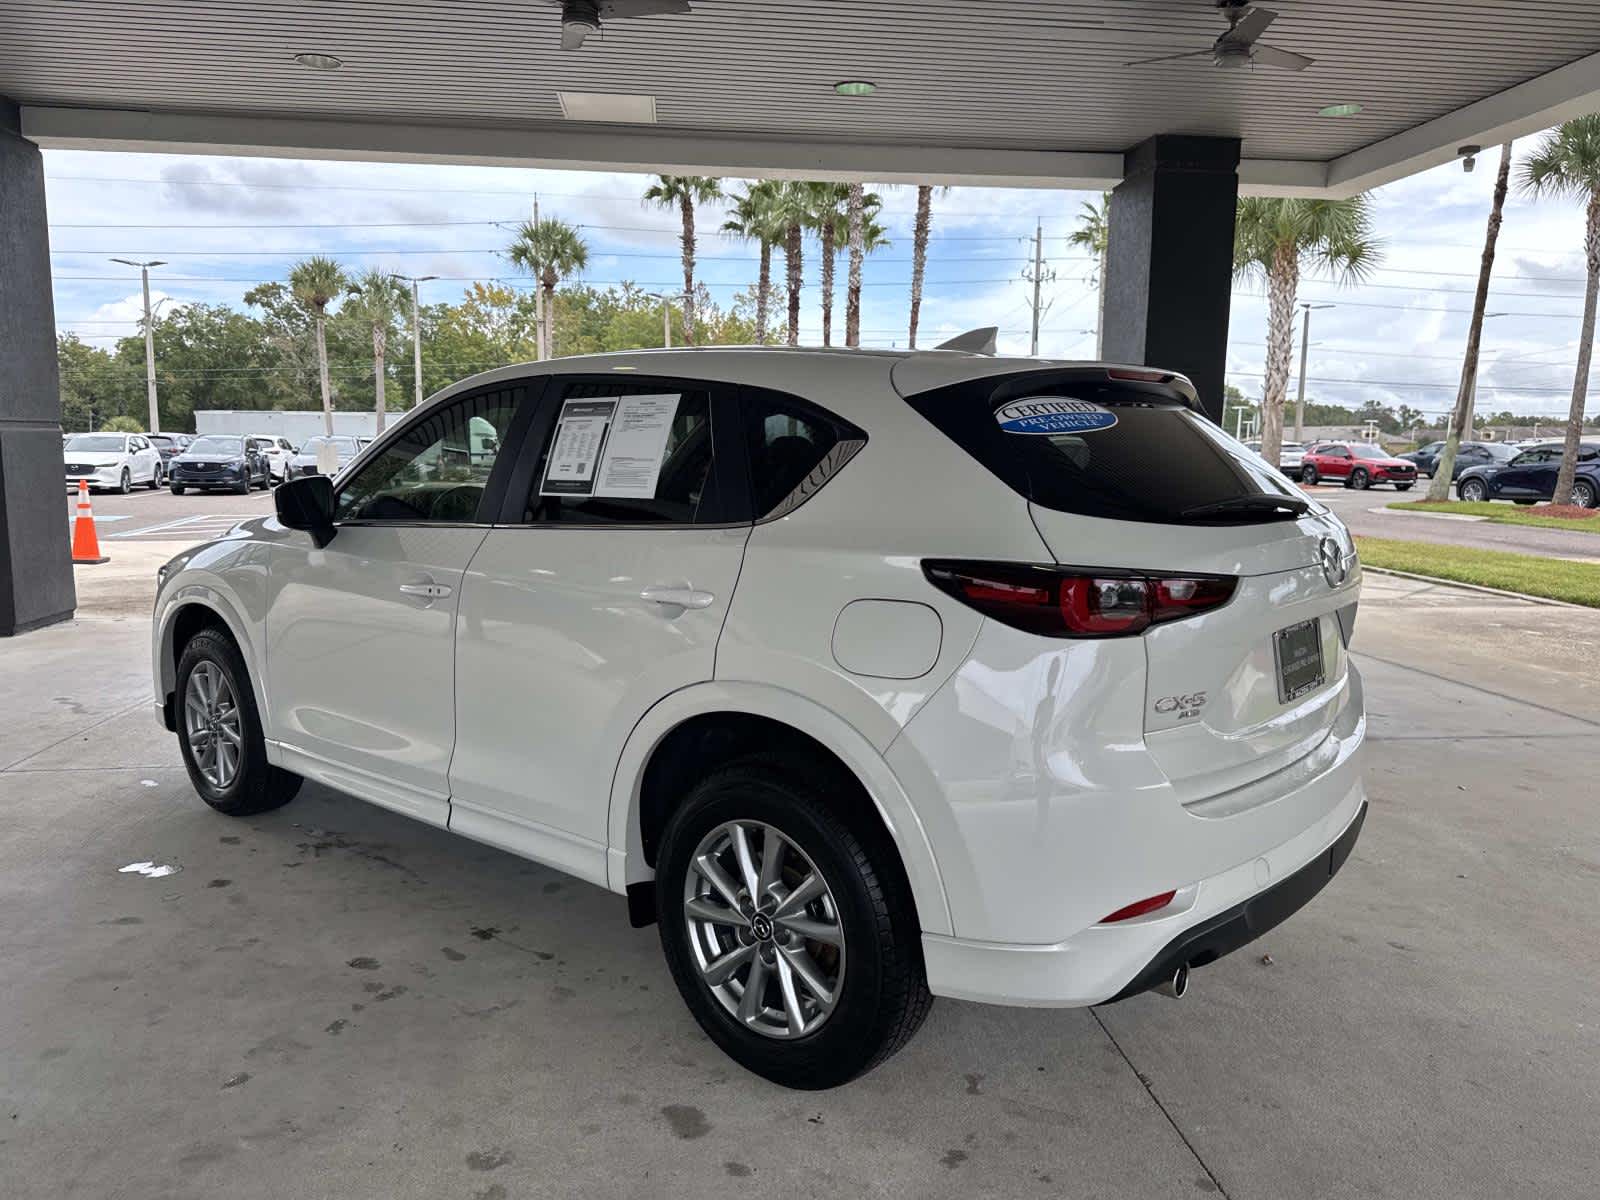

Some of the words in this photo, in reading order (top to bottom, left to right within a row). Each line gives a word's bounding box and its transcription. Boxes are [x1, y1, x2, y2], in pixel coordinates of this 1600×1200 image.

[1002, 402, 1097, 419] CERTIFIED
[1018, 413, 1103, 427] PRE-OWNED
[1039, 419, 1101, 430] VEHICLE
[1154, 690, 1207, 714] CX-5
